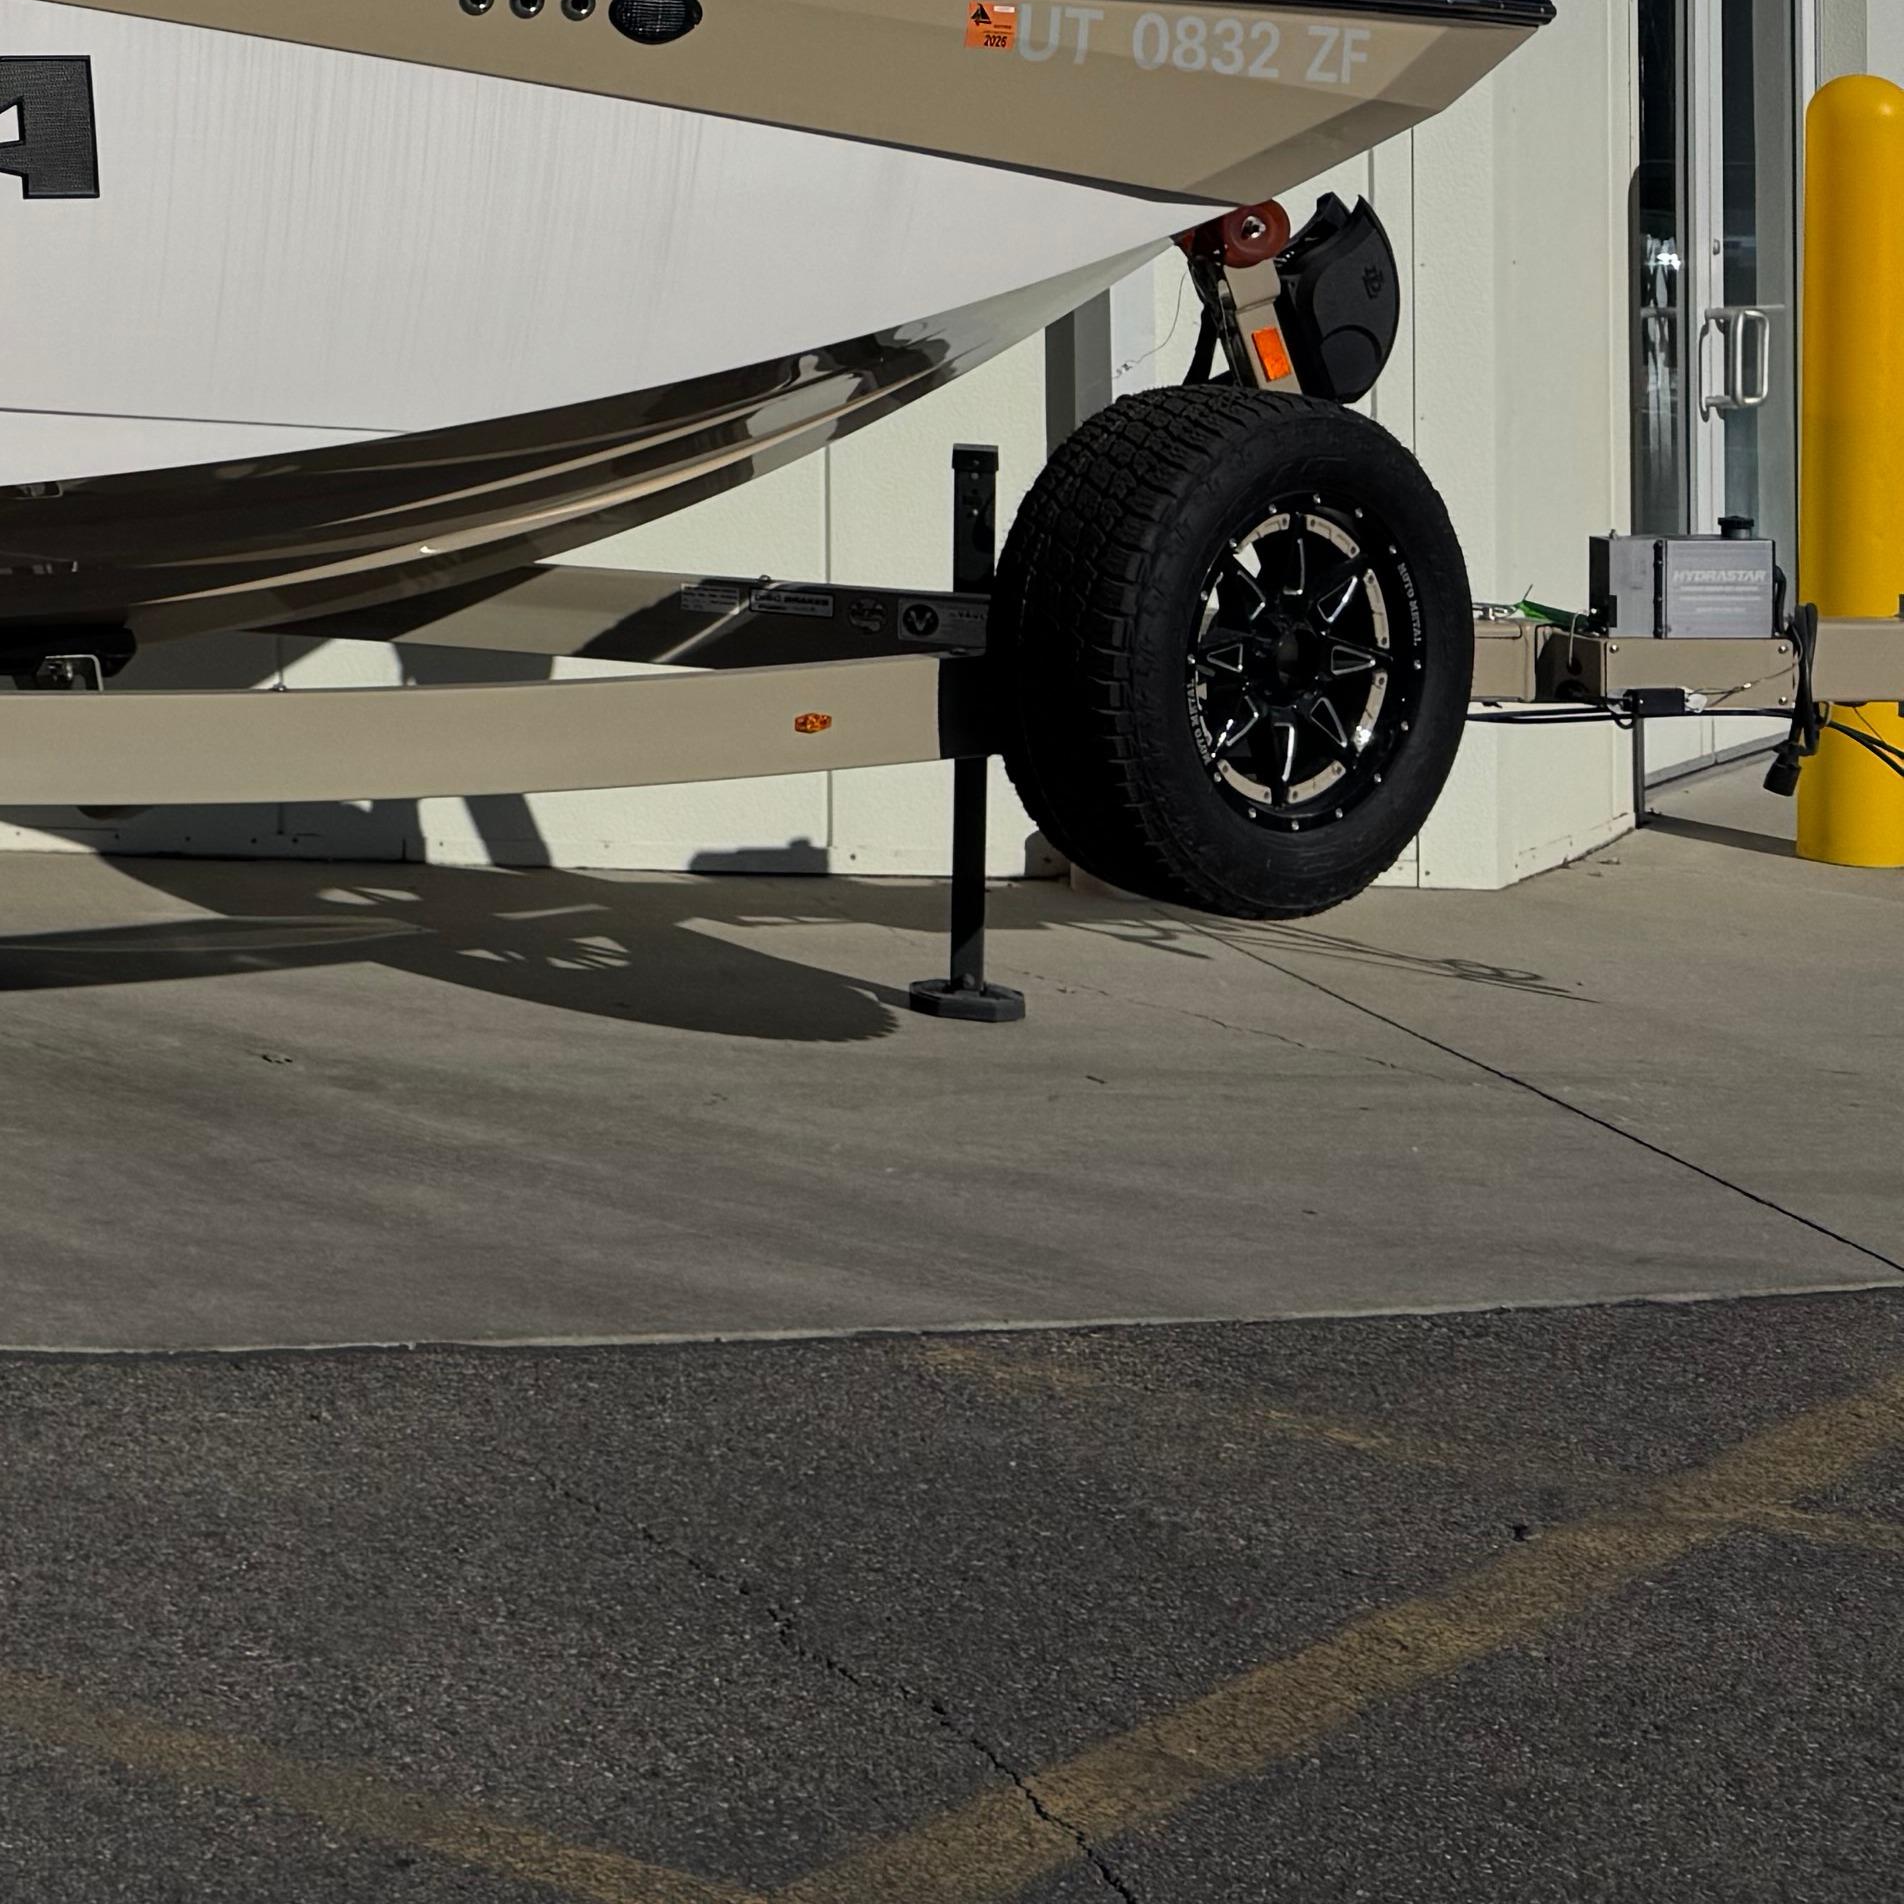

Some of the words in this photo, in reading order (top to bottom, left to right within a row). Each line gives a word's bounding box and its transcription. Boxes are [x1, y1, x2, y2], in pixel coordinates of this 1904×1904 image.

[1017, 3, 1104, 65] UT
[1132, 11, 1281, 79] 0832
[1305, 24, 1372, 85] ZF
[1397, 562, 1415, 598] MOTO
[1409, 600, 1422, 647] METAL
[1673, 570, 1767, 584] HYDRASTAR
